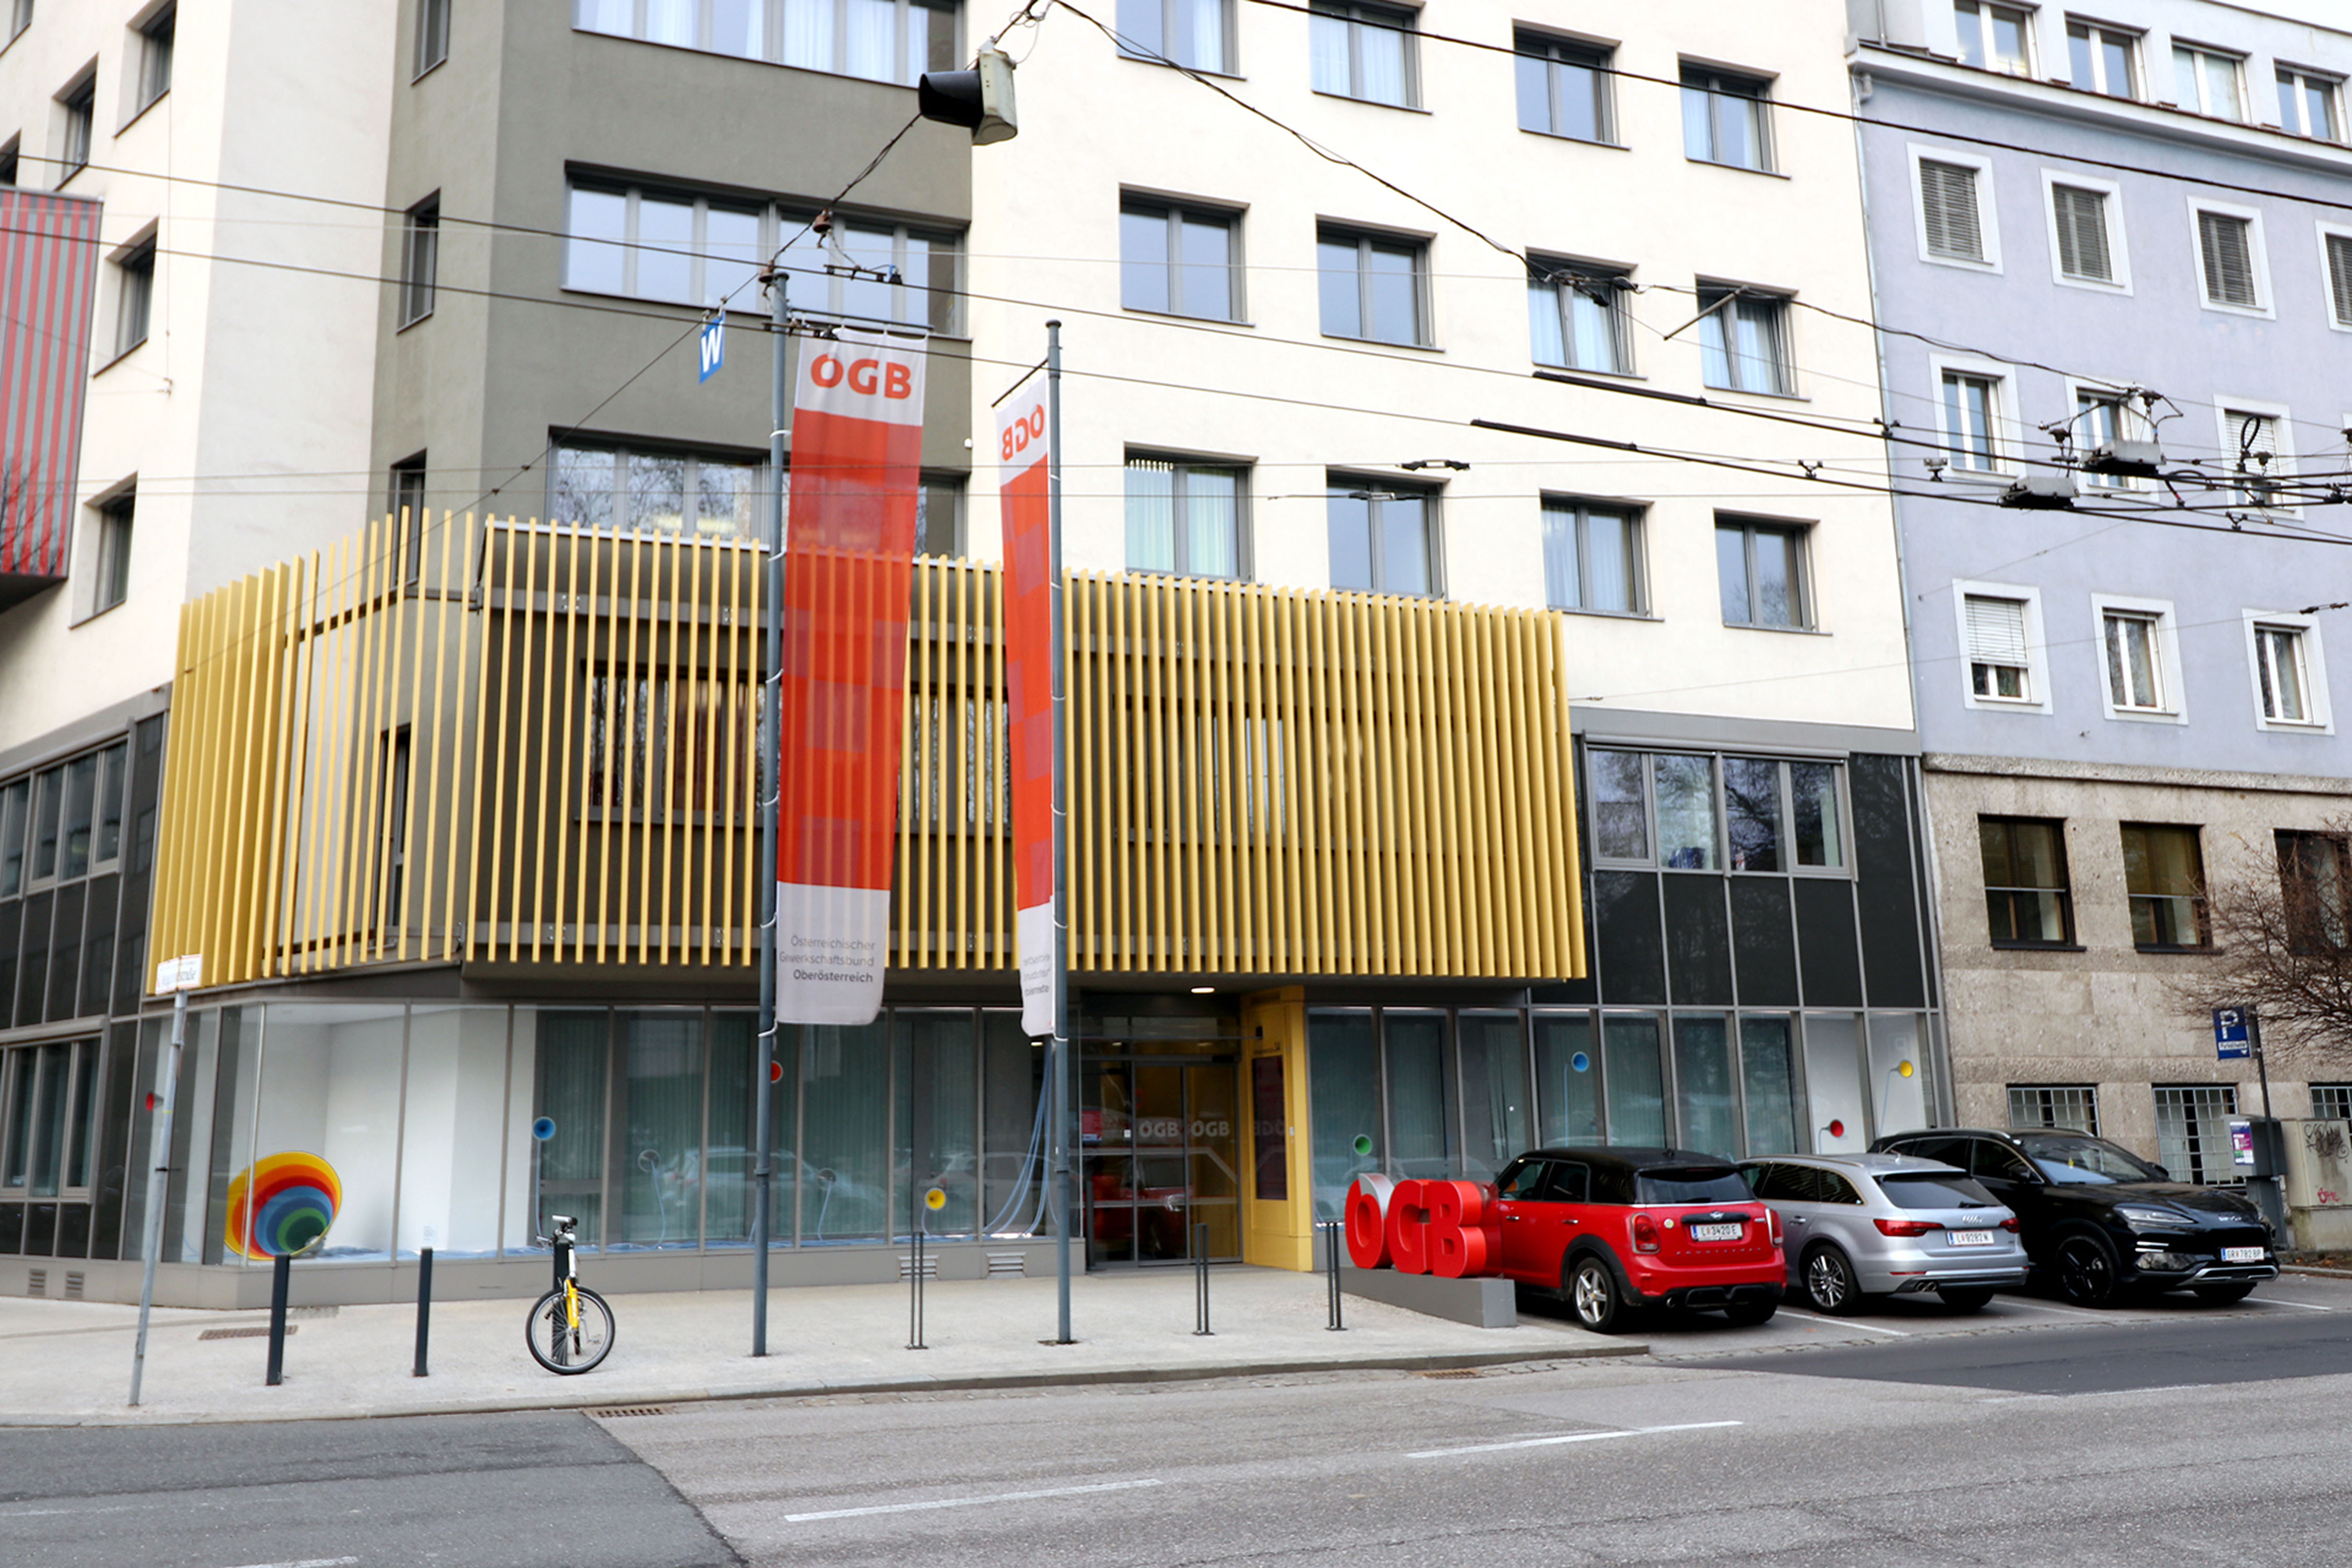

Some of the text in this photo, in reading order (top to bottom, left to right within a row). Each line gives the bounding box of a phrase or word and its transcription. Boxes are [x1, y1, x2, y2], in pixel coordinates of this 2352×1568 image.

[701, 321, 724, 373] W
[791, 933, 875, 950] Österreichischer
[793, 969, 873, 982] Oberösterreich
[2219, 1010, 2239, 1040] P
